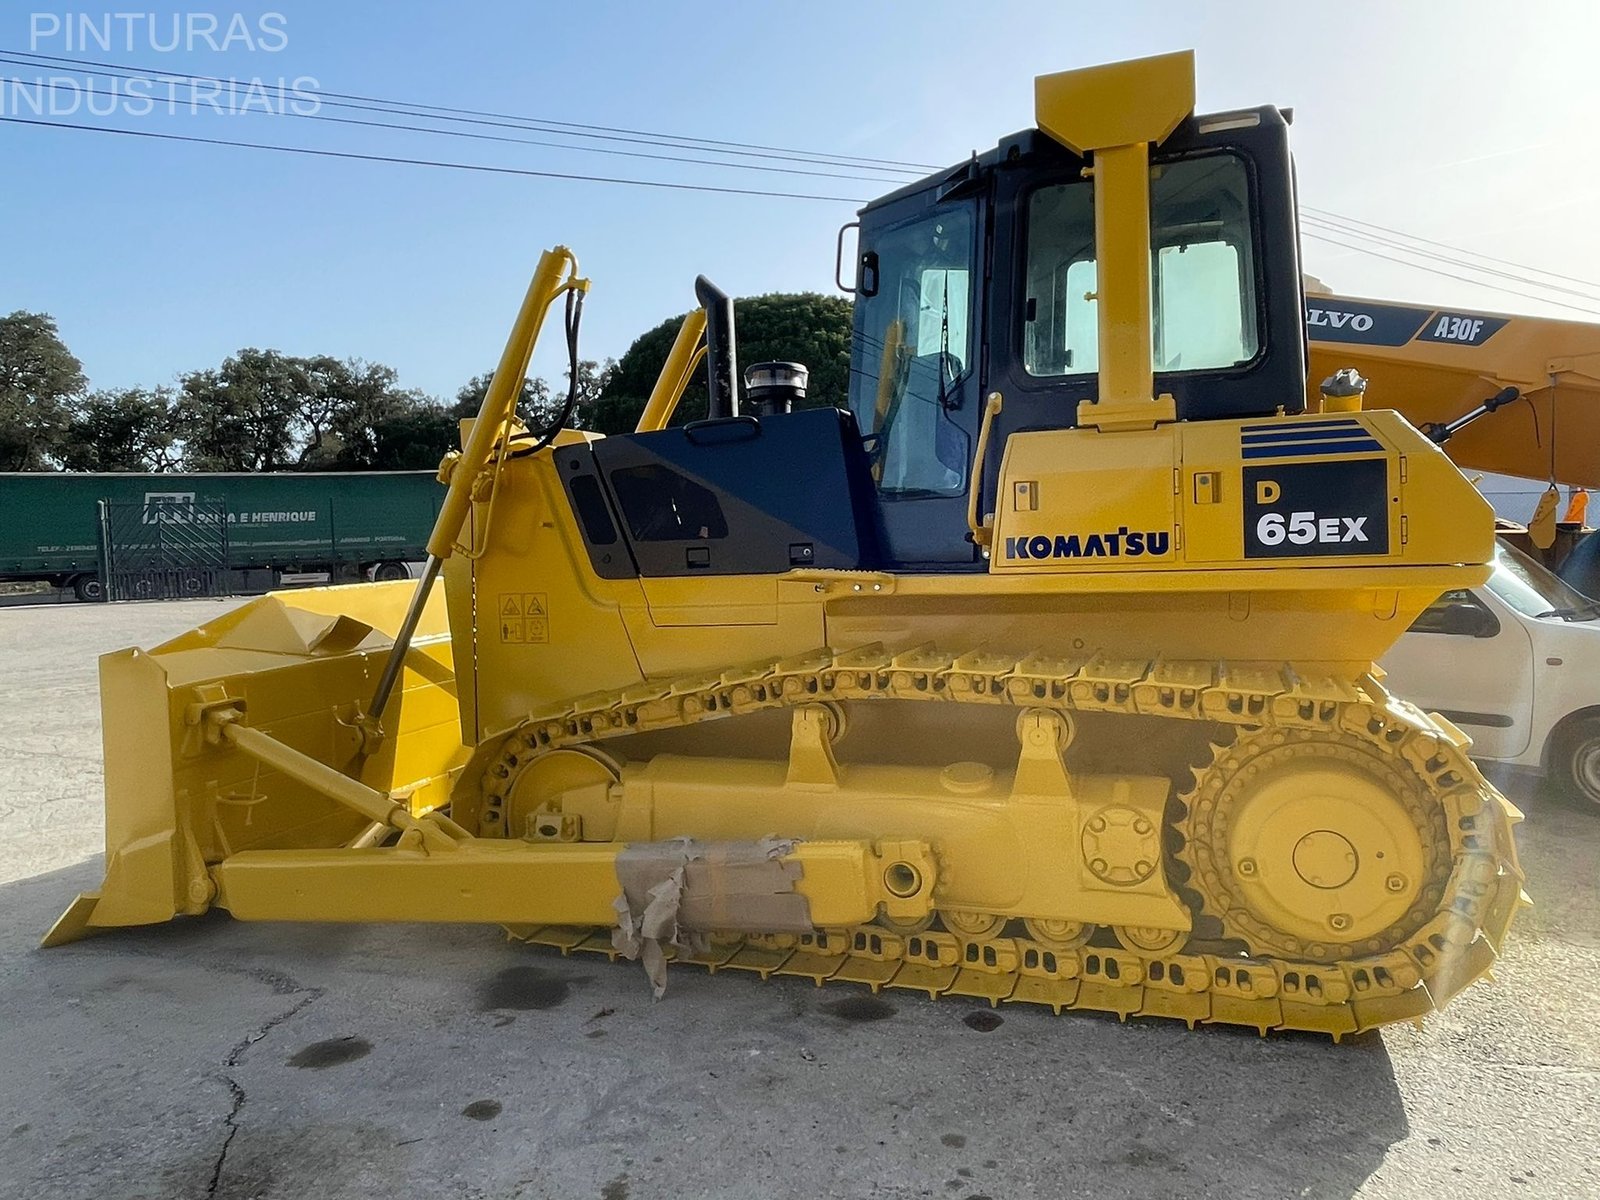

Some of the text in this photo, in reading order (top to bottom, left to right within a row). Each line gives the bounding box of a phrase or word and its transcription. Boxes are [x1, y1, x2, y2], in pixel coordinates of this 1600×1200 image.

[1306, 309, 1374, 331] LVO
[1434, 316, 1484, 342] A30F
[1256, 481, 1281, 504] D
[240, 512, 249, 523] E
[252, 511, 316, 523] HENRIQUE
[1256, 512, 1369, 546] 65EX
[1006, 527, 1169, 560] KOMATSU
